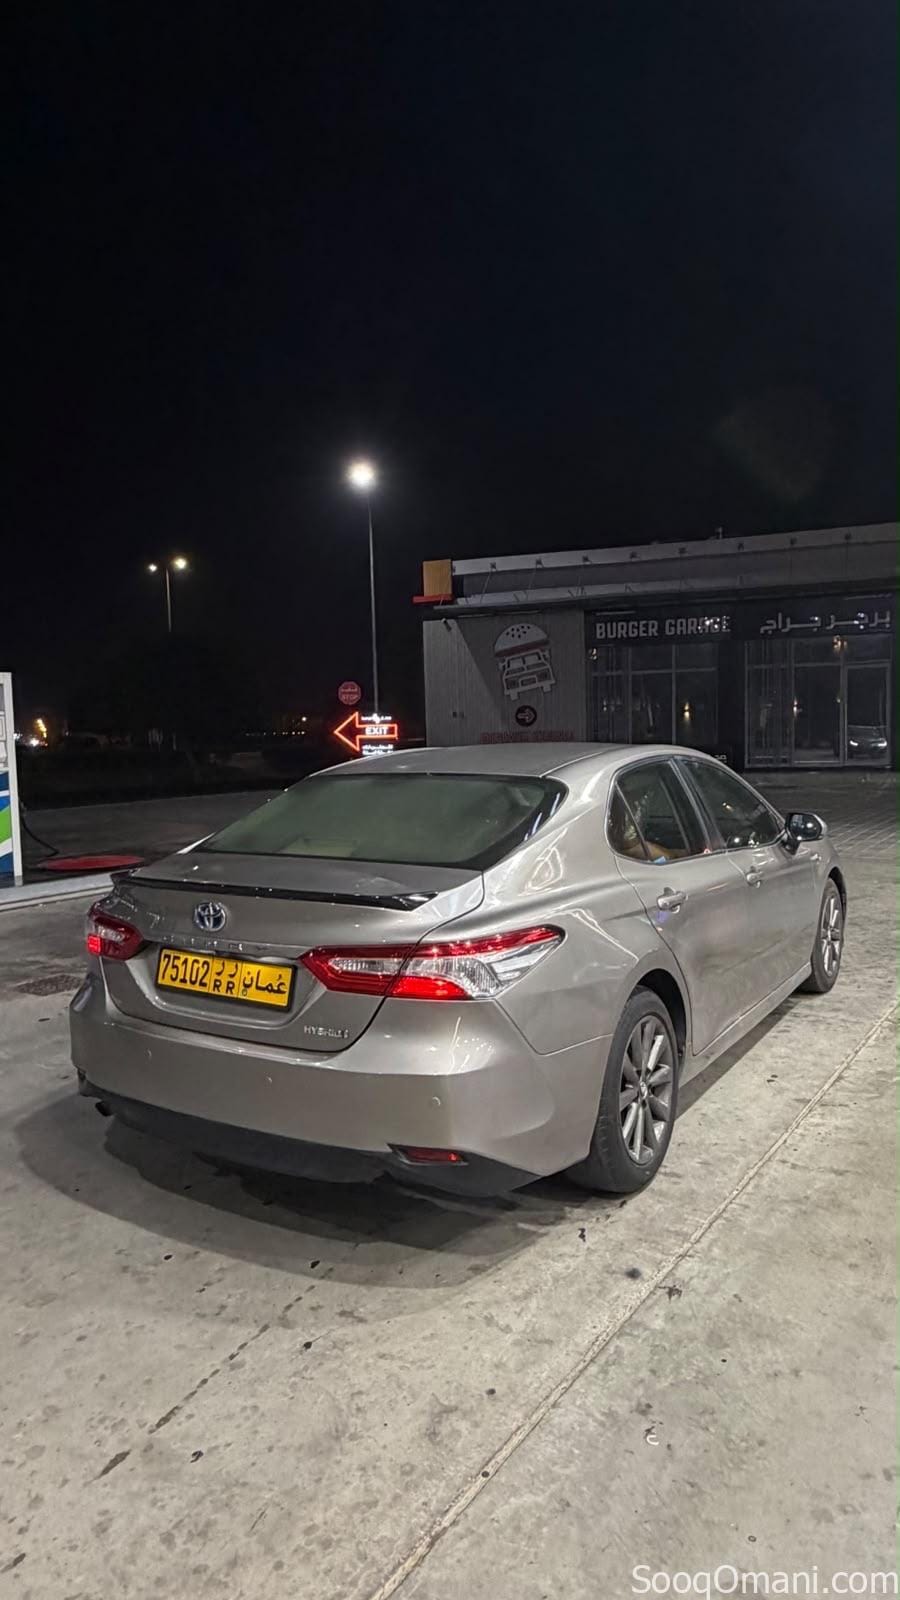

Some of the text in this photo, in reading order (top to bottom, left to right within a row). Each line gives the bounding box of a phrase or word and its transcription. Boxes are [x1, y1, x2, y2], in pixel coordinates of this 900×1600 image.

[595, 615, 731, 640] BURGER GARAGE
[365, 726, 389, 735] EXIT
[160, 953, 210, 988] 75102
